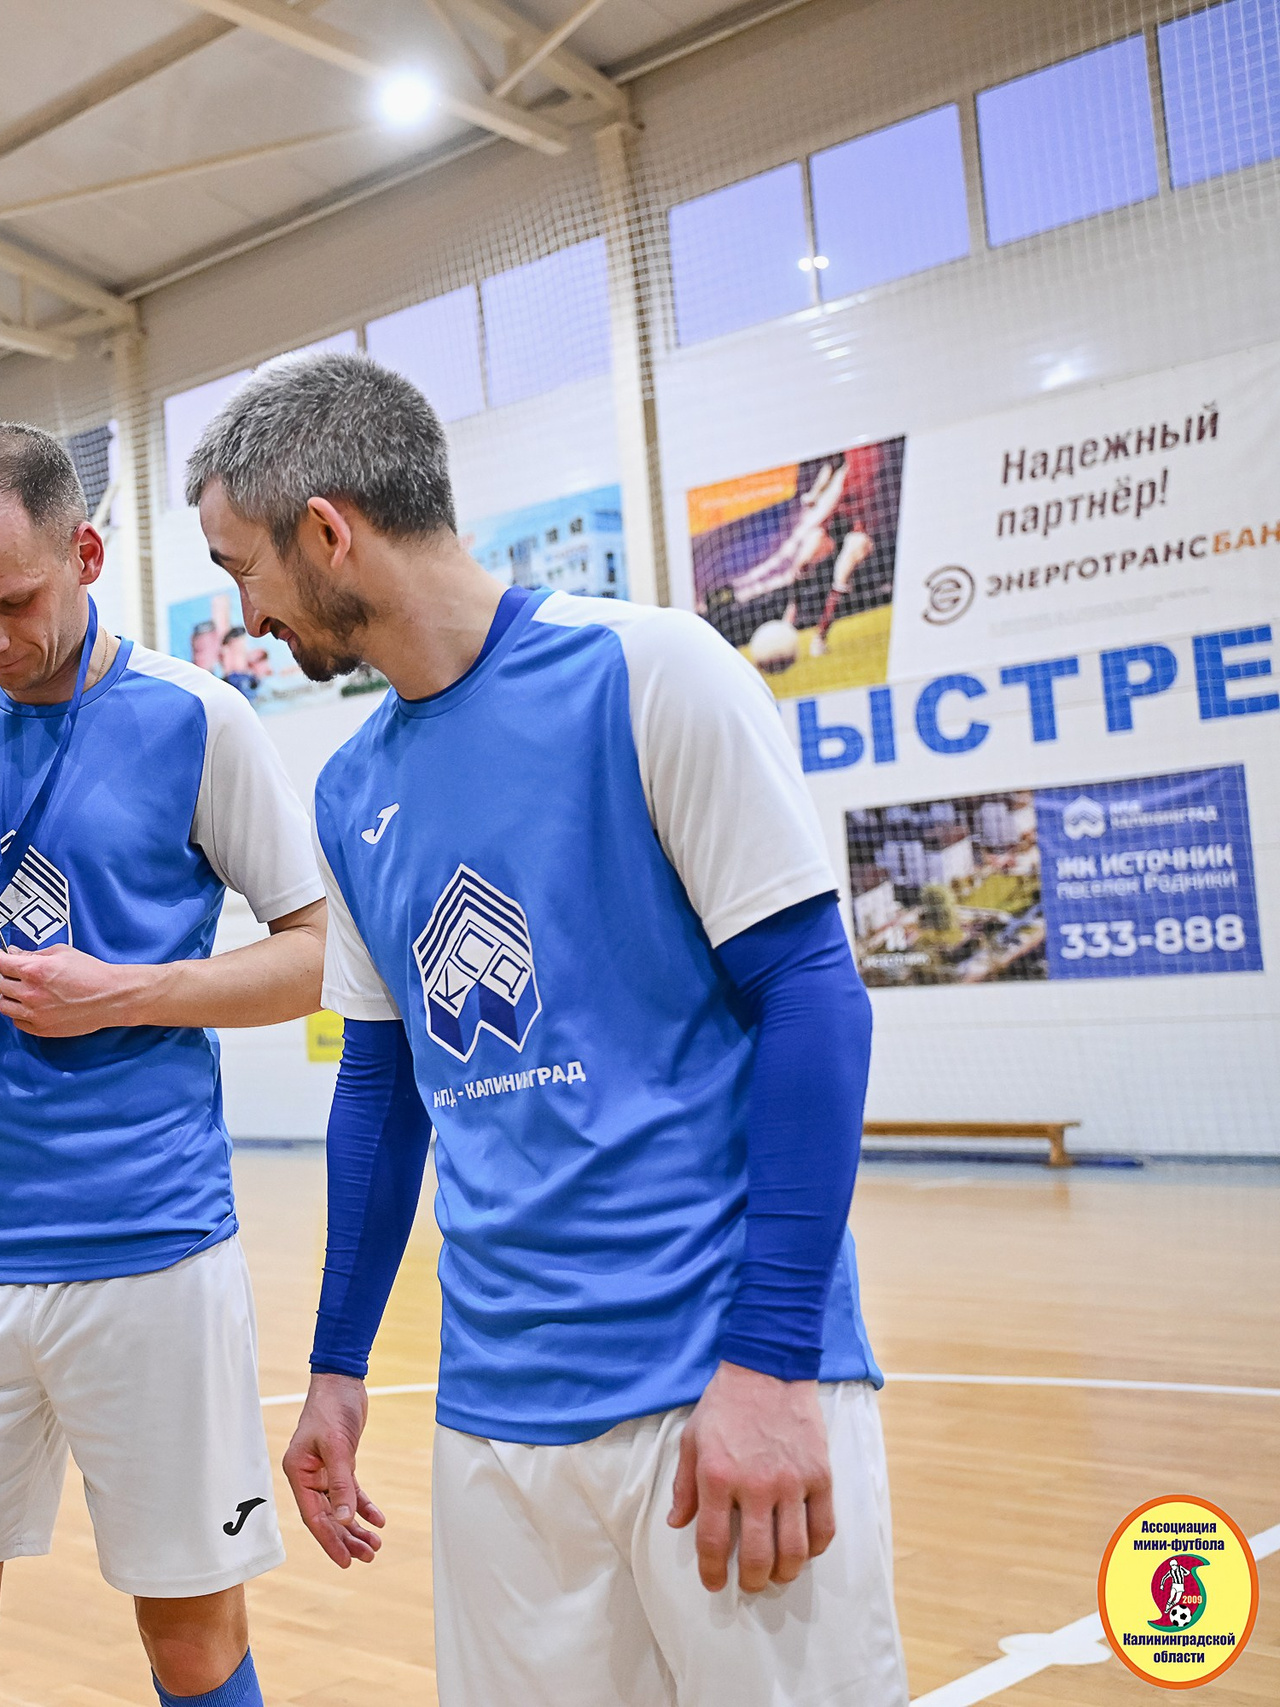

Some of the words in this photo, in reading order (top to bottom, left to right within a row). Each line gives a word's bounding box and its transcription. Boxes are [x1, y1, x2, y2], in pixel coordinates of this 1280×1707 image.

[1001, 401, 1220, 485] Надежный
[997, 468, 1169, 537] партнёр!
[777, 624, 1280, 773] ЫСТРЕ
[1101, 842, 1233, 876] ИСТОЧНИК
[1059, 912, 1246, 961] 333-888
